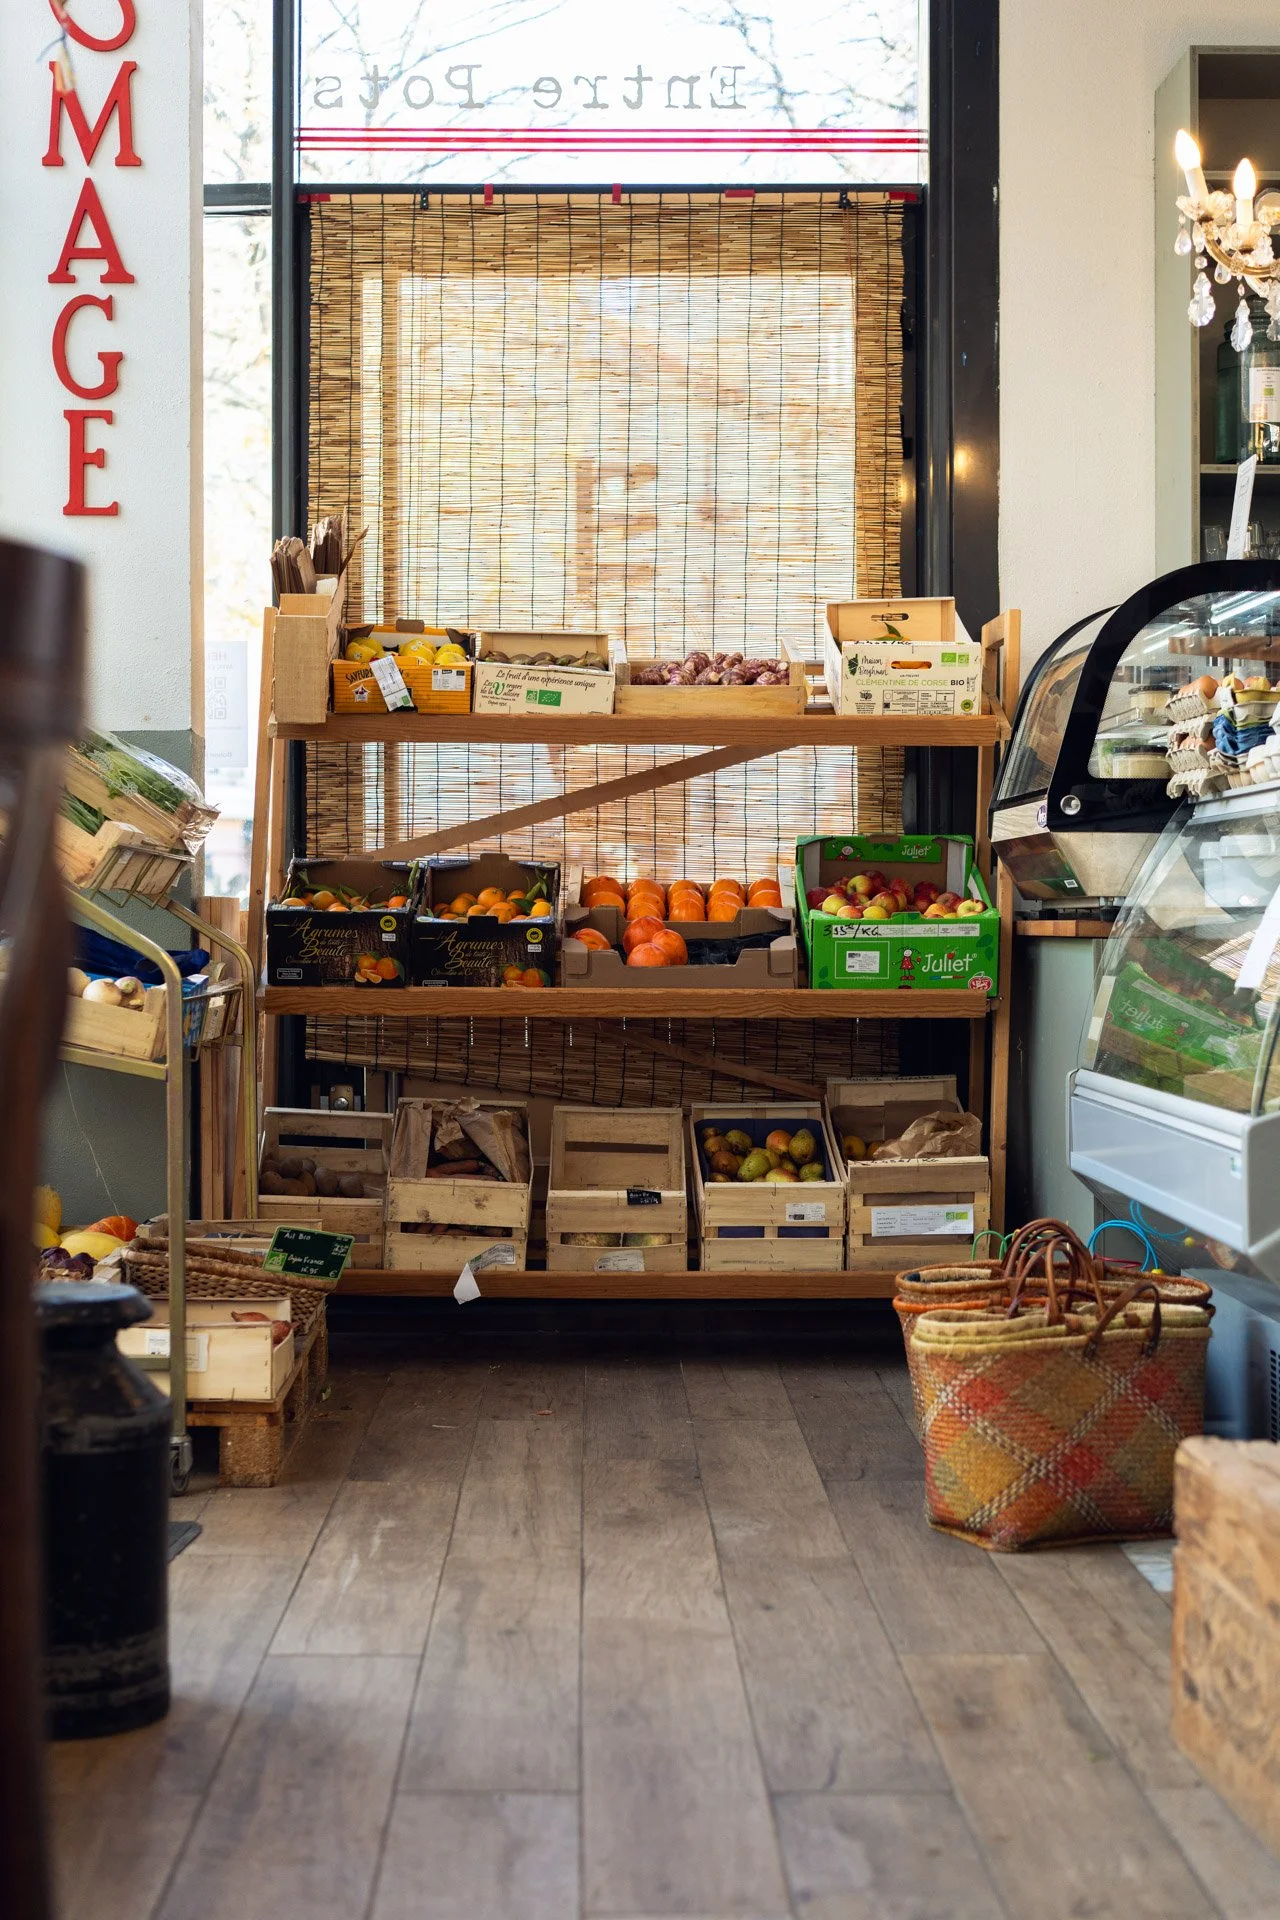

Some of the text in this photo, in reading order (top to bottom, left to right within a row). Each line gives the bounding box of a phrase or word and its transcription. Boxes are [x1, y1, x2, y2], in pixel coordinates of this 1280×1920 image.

[496, 669, 596, 691] Le fruit d'une expérience unique
[902, 844, 929, 856] Juliet
[288, 917, 359, 942] Agrumes
[434, 930, 504, 954] Agrumes
[921, 953, 973, 973] Juliet
